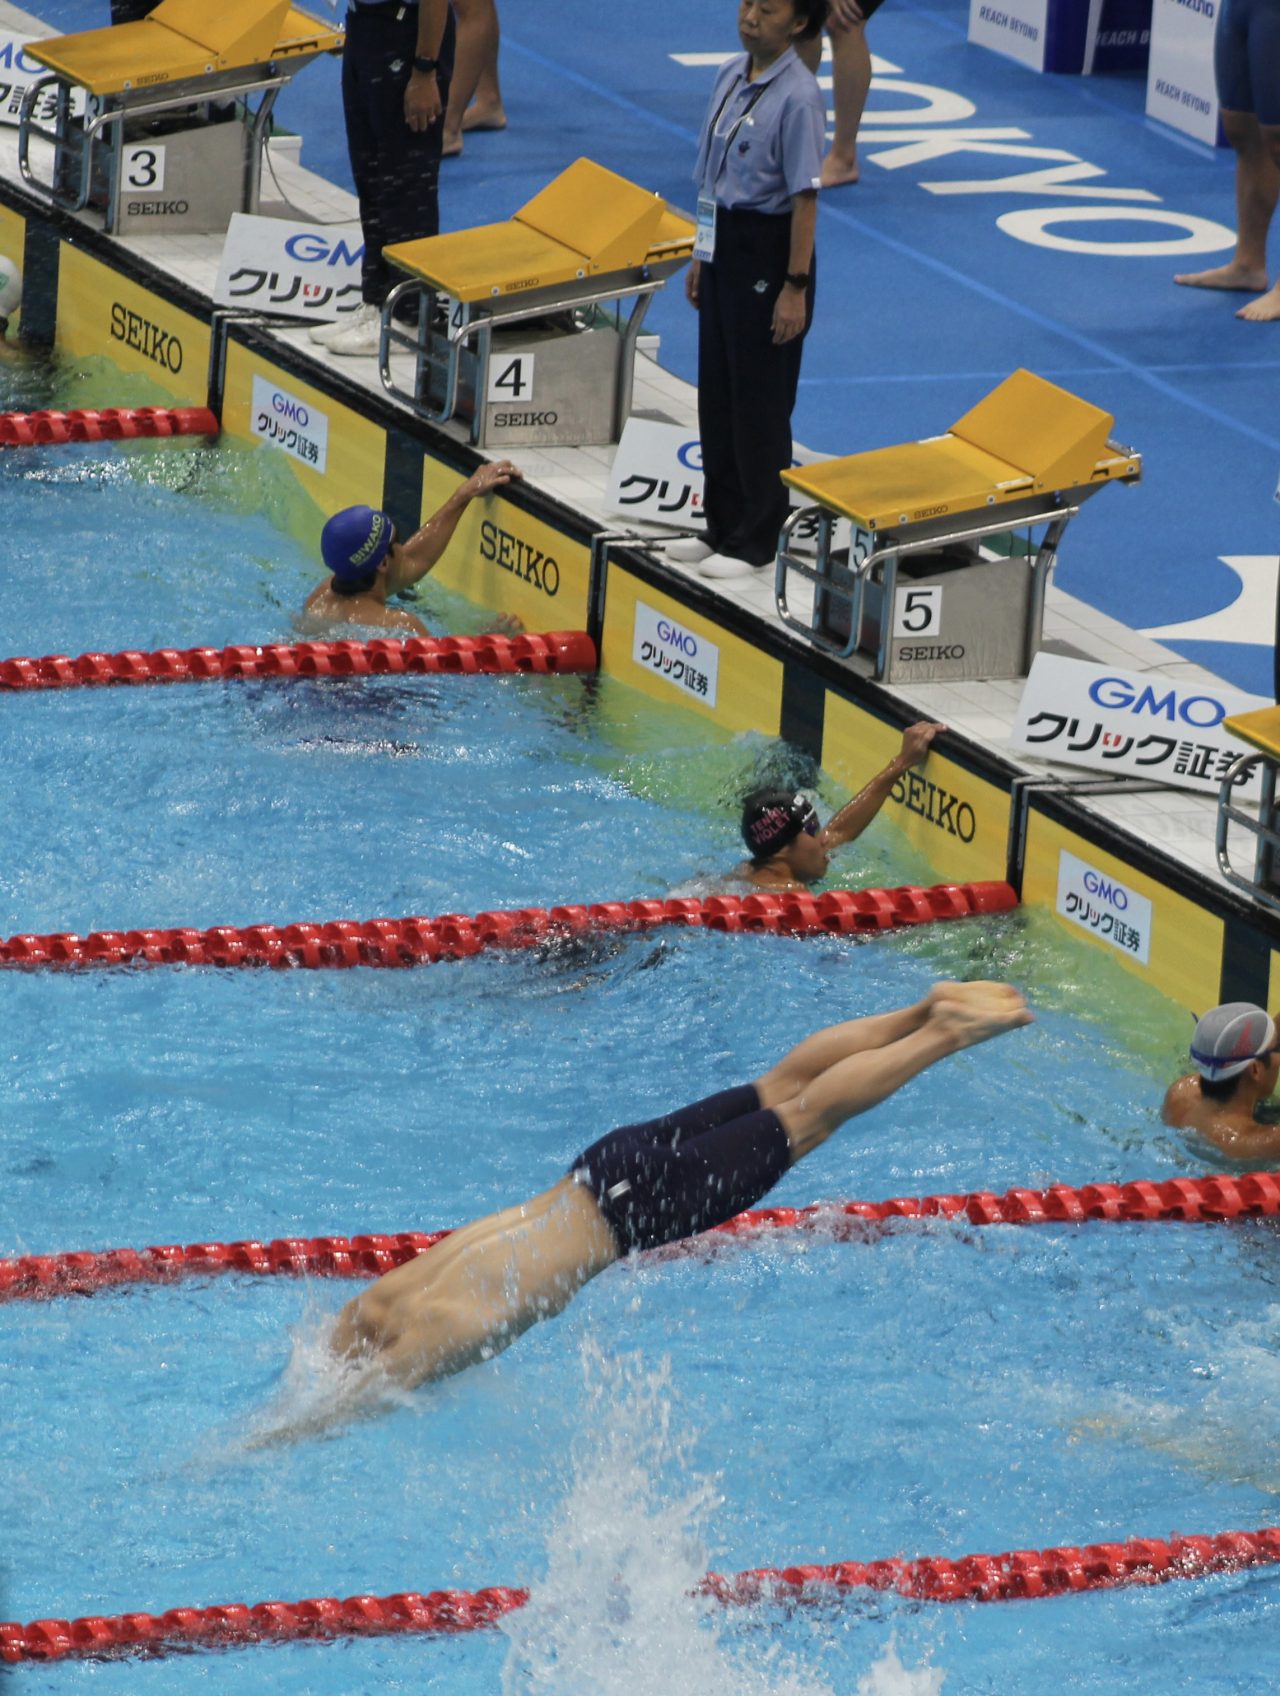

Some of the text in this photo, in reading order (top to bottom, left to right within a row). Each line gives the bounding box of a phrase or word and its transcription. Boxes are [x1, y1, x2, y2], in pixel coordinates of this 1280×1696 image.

[979, 6, 1039, 42] REACH BEYOND
[1155, 79, 1211, 116] REACH BEYOND
[128, 150, 157, 187] 3
[127, 200, 189, 217] SEIKO
[285, 234, 365, 266] GM
[505, 278, 540, 292] SEIKO
[110, 301, 183, 375] SEIKO
[494, 358, 527, 397] 4
[272, 392, 309, 428] GMO
[494, 411, 558, 428] SEIKO
[258, 412, 319, 464] クリック証券
[913, 503, 949, 520] SEIKO
[348, 513, 382, 565] BIWAKO
[479, 518, 560, 597] SEIKO
[853, 527, 870, 569] 5
[902, 591, 933, 632] 5
[657, 620, 698, 658] GMO
[899, 644, 965, 662] SEIKO
[641, 641, 709, 697] クリック証券
[1088, 677, 1227, 729] GMO
[1025, 711, 1258, 787] クリック証券
[1083, 870, 1129, 911] GMO
[1065, 891, 1141, 953] クリック証券
